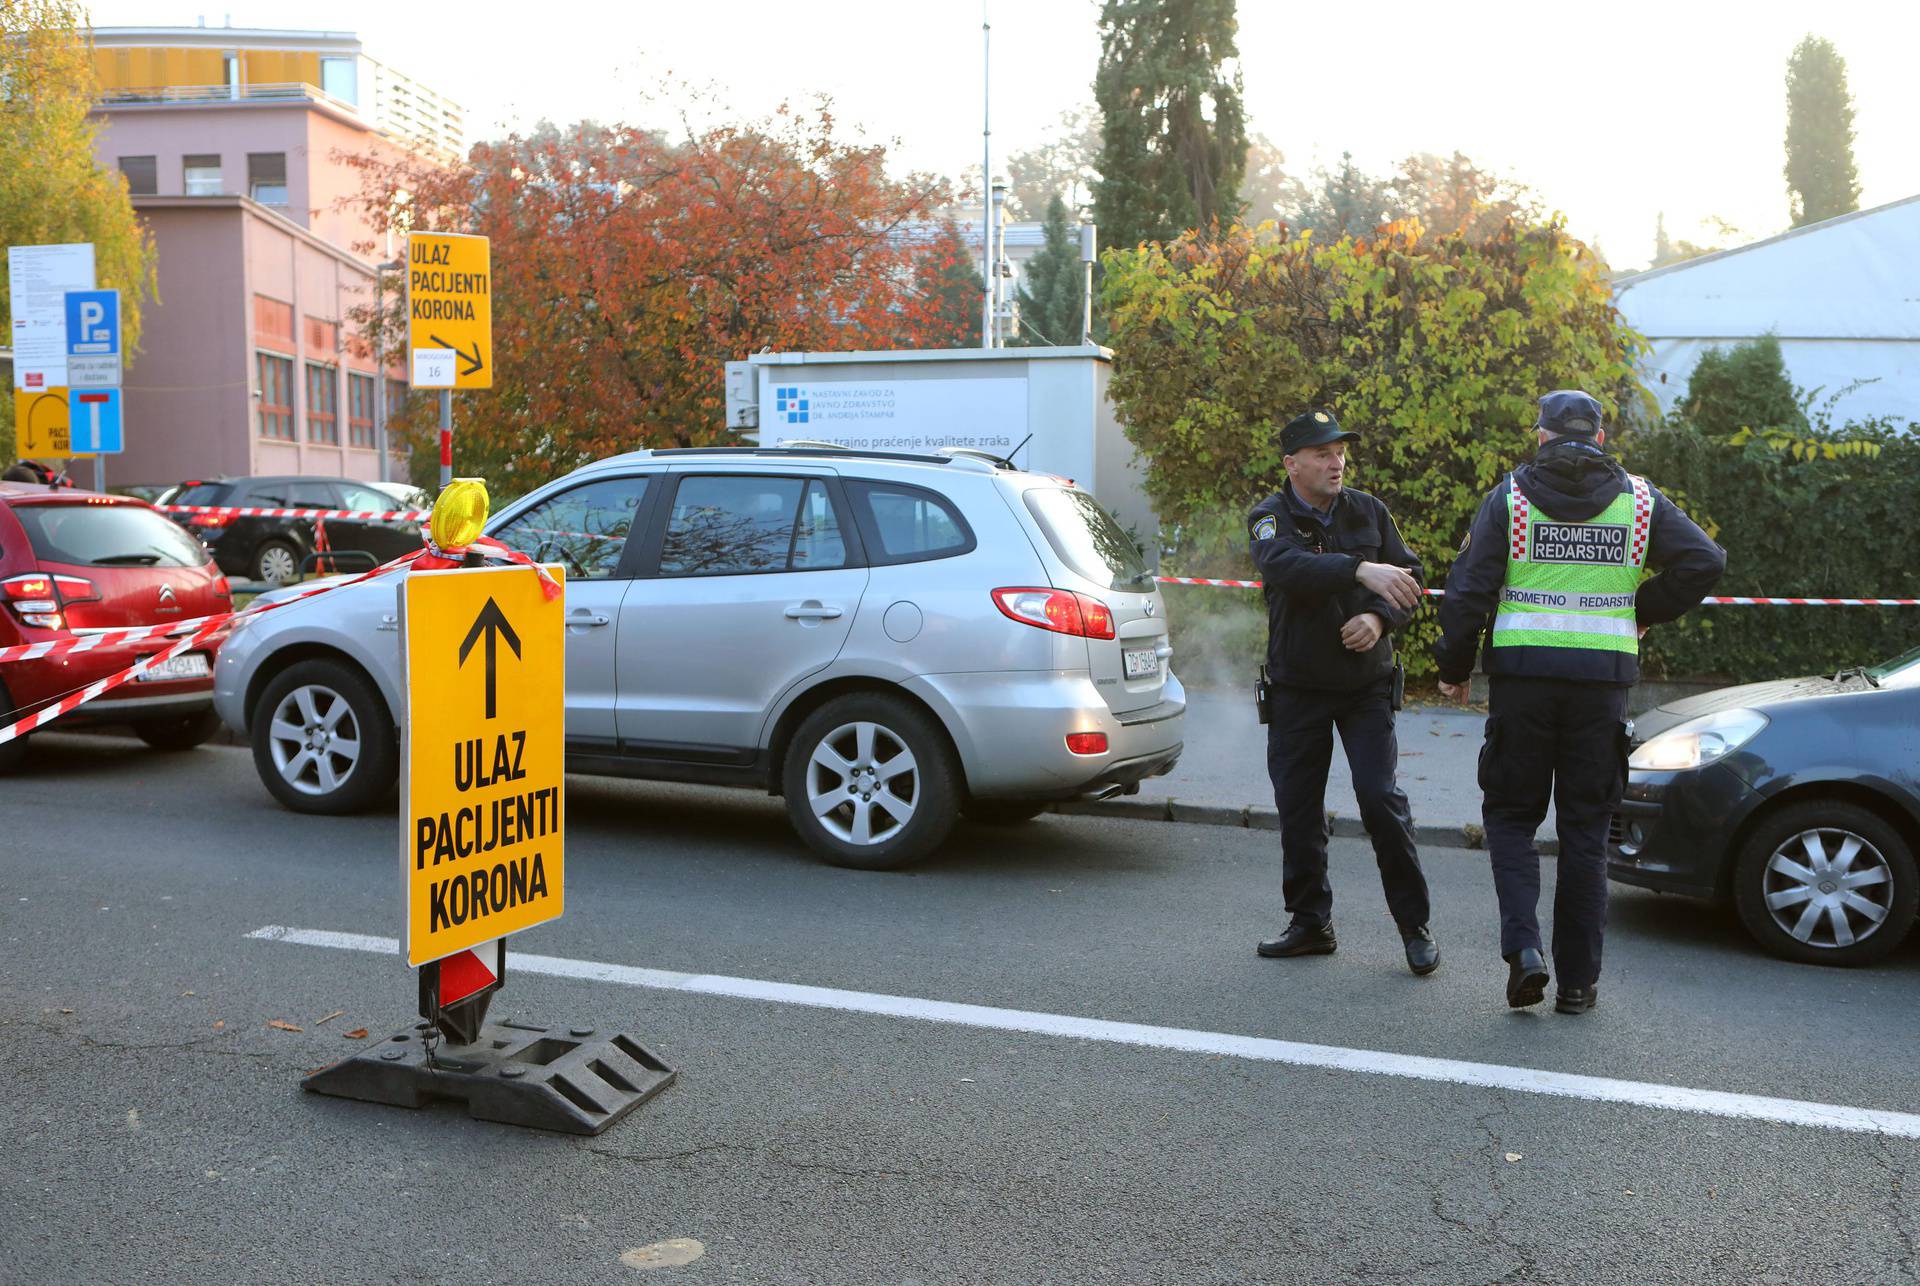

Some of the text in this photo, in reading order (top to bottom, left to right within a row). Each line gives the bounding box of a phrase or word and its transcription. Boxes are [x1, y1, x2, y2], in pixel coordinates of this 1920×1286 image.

[412, 243, 451, 265] ULAZ
[411, 271, 487, 294] PACIJENTI
[412, 299, 475, 320] KORONA
[428, 366, 441, 377] 16
[884, 389, 895, 397] ZA
[812, 400, 895, 409] JAVNO ZDRAVSTVO
[834, 436, 868, 449] trajno
[872, 435, 922, 449] praćenje
[925, 435, 976, 447] kvalitete
[979, 435, 1010, 446] zraka
[1539, 526, 1623, 544] PROMETNO
[1535, 543, 1623, 561] REDARSTVO
[1505, 589, 1635, 608] PROMETNO REDARSTV
[455, 730, 526, 792] ULAZ
[417, 787, 558, 870] PACIJENTI
[430, 853, 548, 934] KORONA
